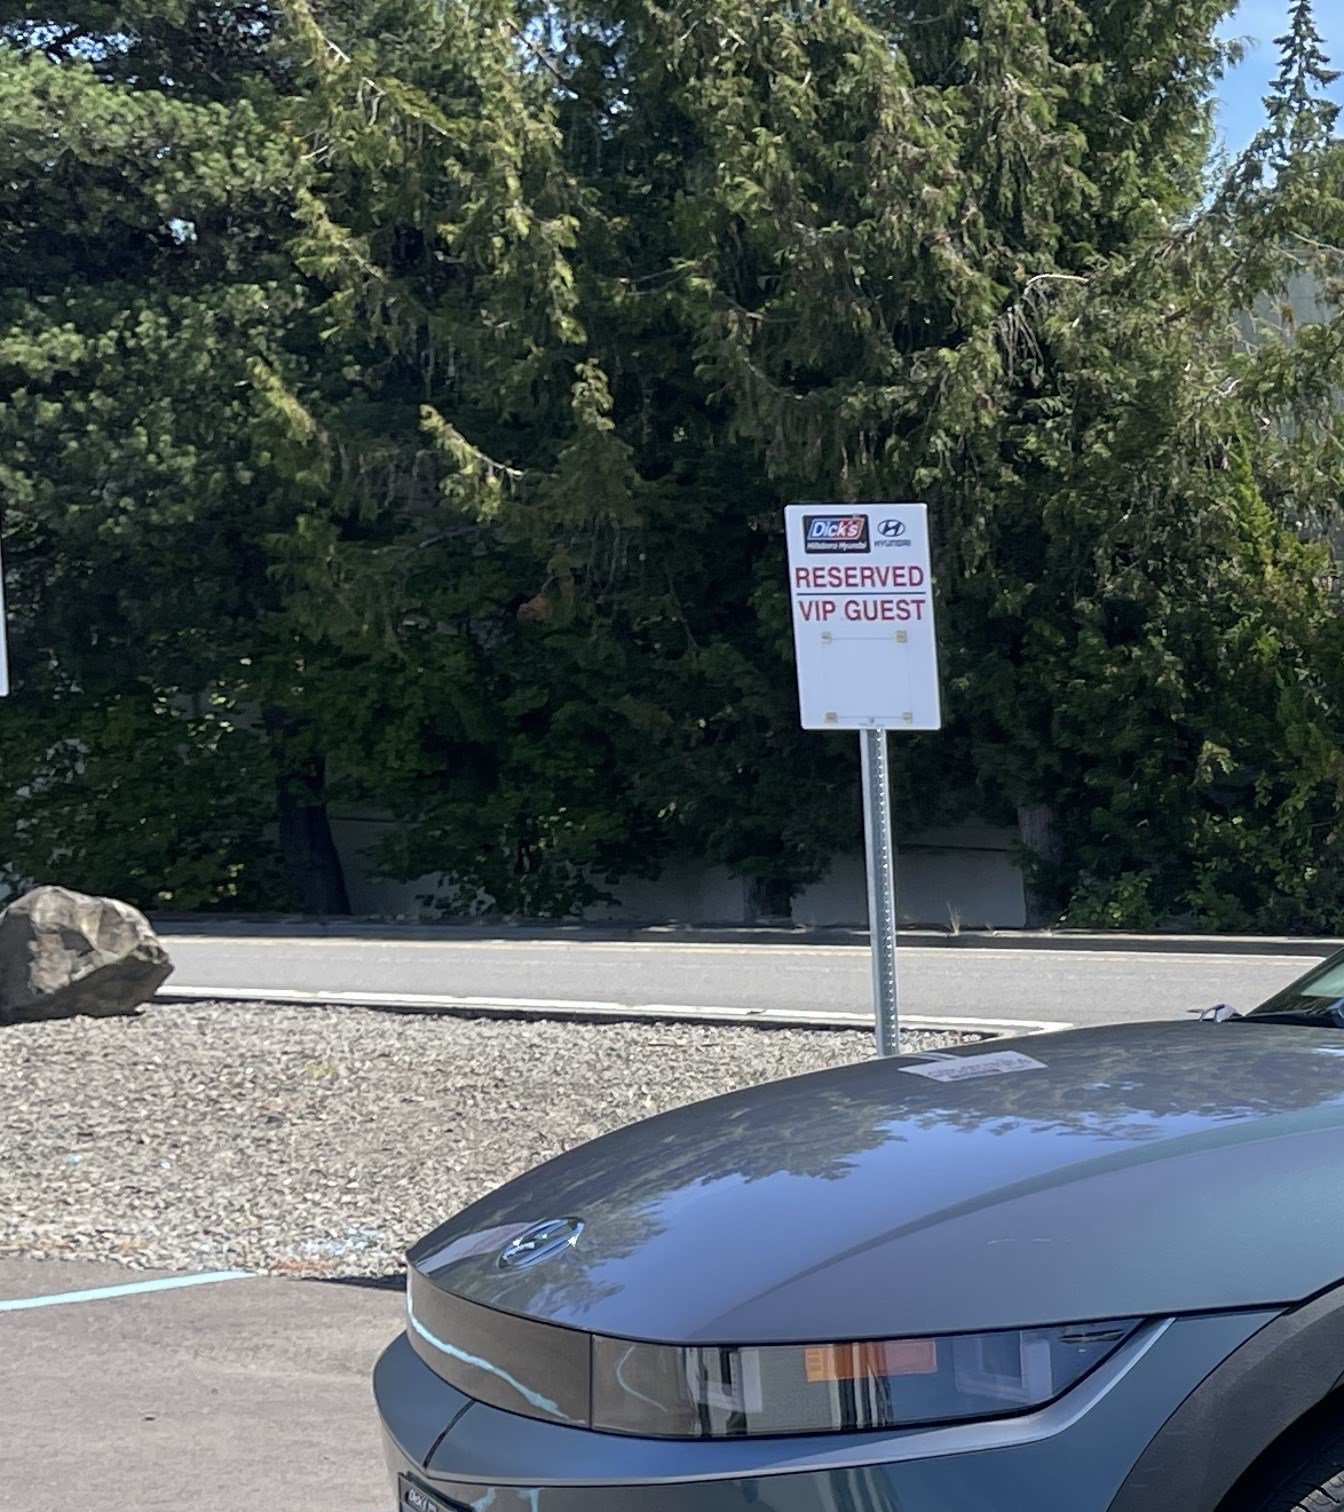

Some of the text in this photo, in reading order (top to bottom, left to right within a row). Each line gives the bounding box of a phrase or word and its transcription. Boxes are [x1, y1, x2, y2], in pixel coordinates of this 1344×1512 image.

[795, 565, 924, 589] RESERVED
[798, 599, 926, 621] VIP GUEST
